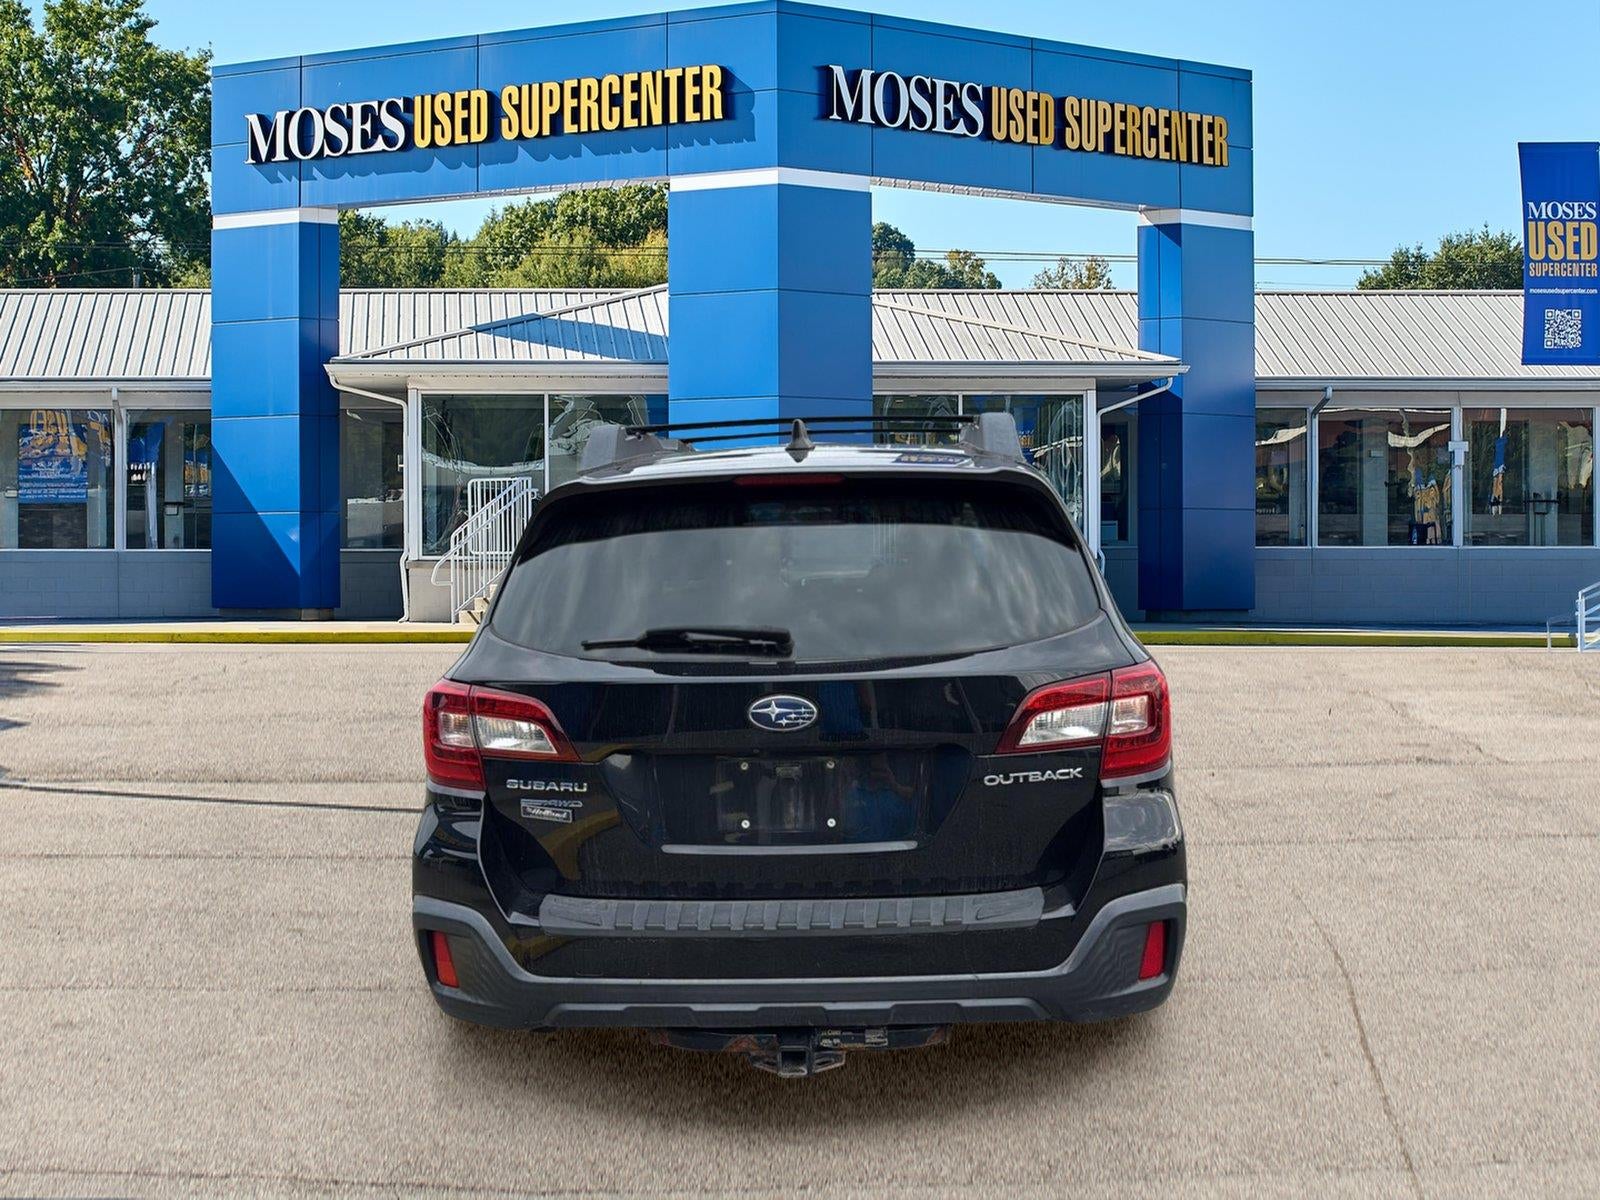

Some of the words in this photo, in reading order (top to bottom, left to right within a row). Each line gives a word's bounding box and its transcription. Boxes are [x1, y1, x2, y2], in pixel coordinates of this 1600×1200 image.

[244, 98, 405, 165] MOSES
[414, 88, 488, 149] USED
[501, 64, 724, 141] SUPERCENTER
[828, 64, 985, 138] MOSES
[991, 86, 1055, 146] USED
[1064, 96, 1230, 167] SUPERCENTER
[1527, 201, 1597, 220] MOSES
[1528, 221, 1598, 261] USED
[1529, 262, 1598, 278] SUPERCENTER
[506, 779, 588, 792] SUBARU
[983, 767, 1083, 786] OUTBACK
